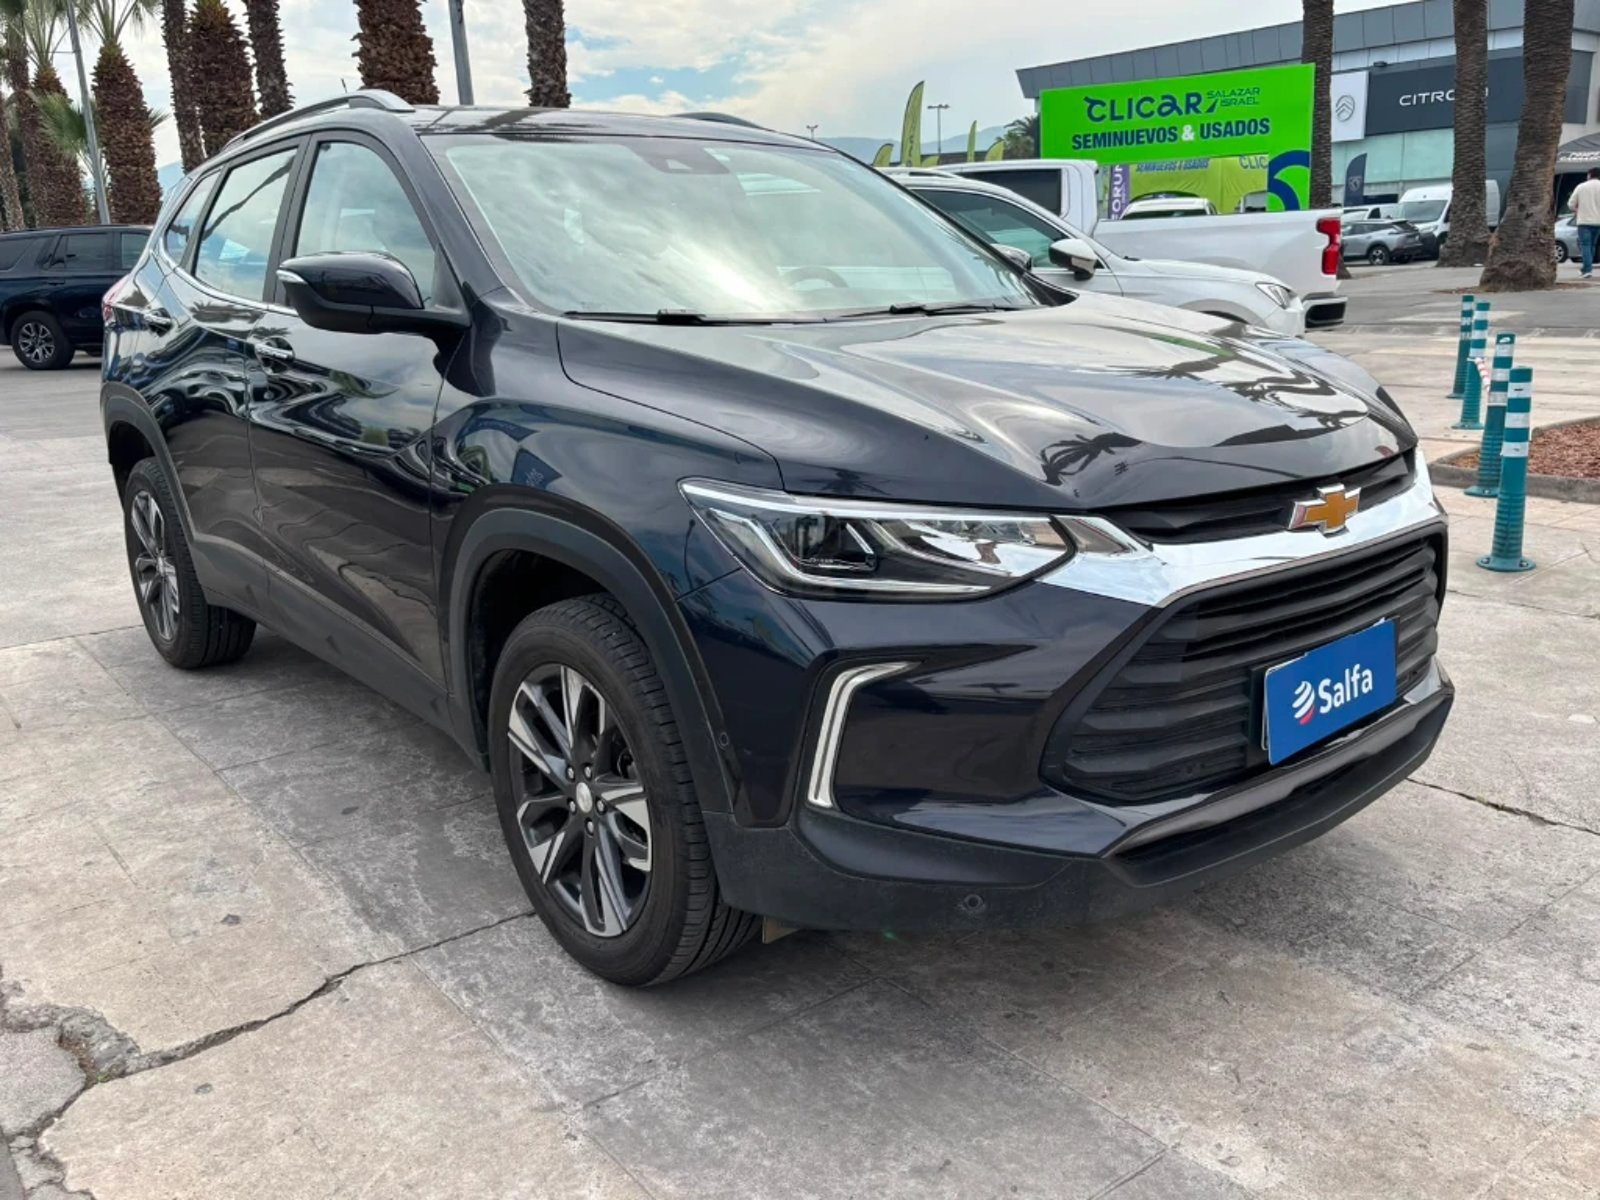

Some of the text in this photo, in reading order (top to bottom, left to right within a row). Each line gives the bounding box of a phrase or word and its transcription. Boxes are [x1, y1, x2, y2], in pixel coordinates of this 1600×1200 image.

[1206, 87, 1260, 99] SALAZAR
[1399, 87, 1489, 106] CITRO
[1072, 118, 1270, 150] SEMINUEVOS & USADOS
[1318, 663, 1373, 714] Salfa
